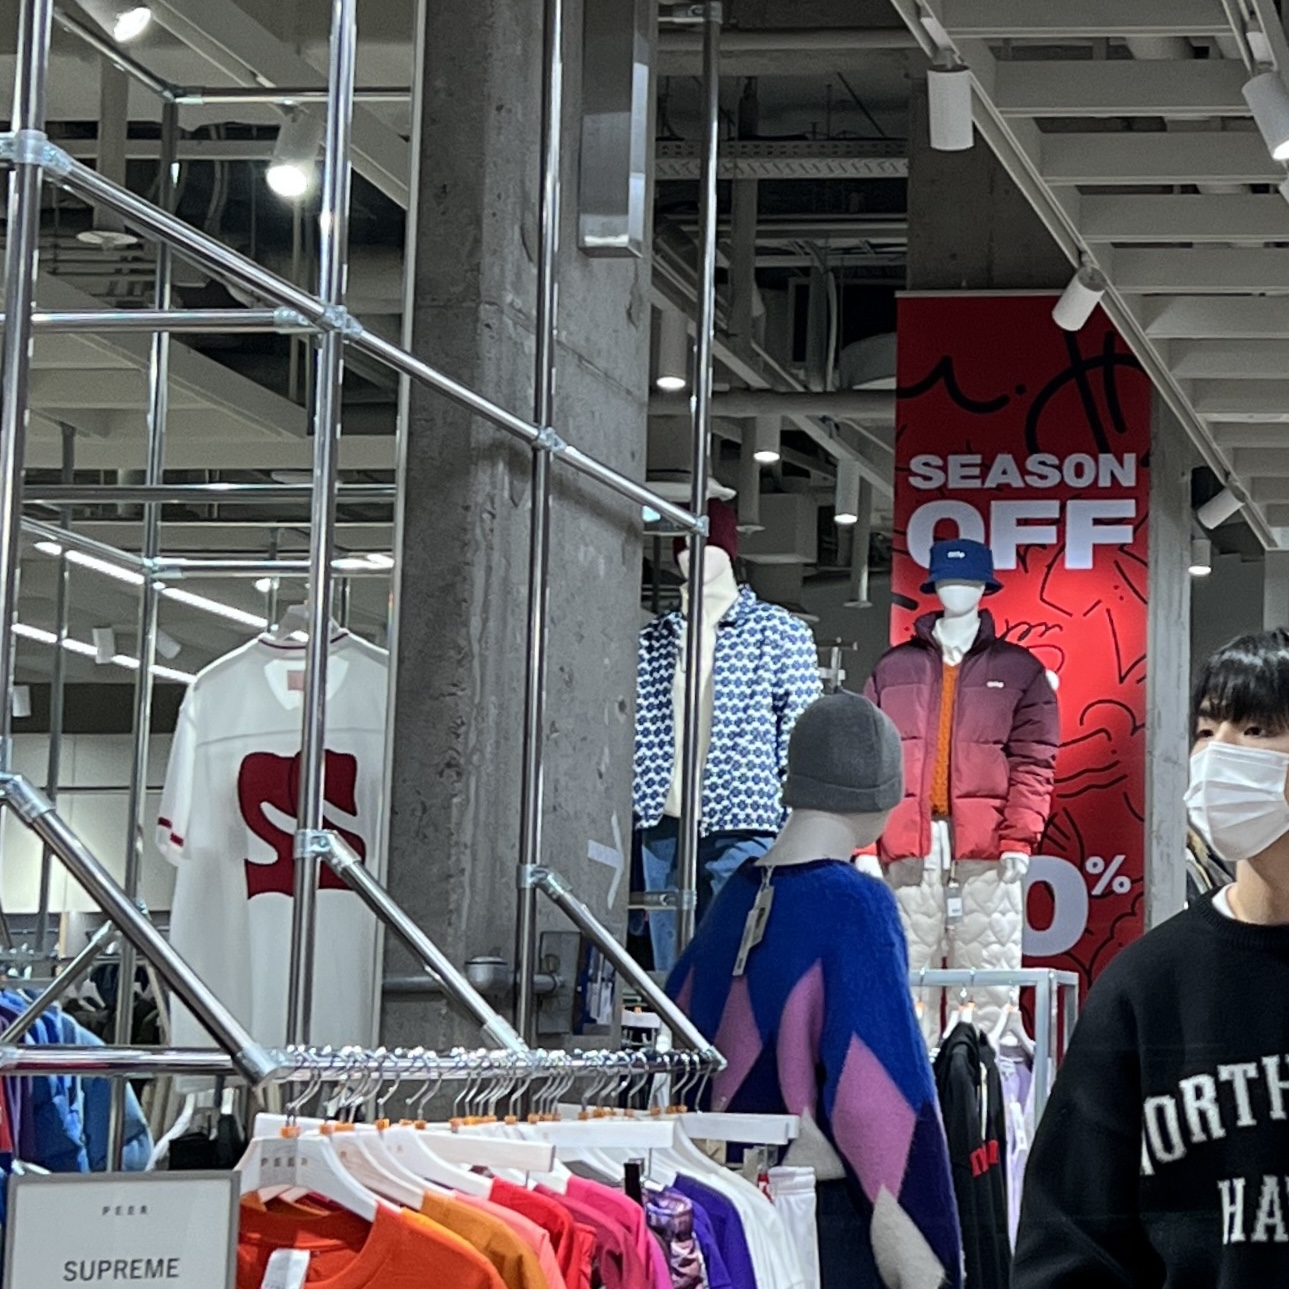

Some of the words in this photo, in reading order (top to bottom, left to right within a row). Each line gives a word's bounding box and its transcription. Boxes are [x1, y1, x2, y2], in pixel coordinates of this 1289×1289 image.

[908, 453, 1136, 489] SEASON
[906, 498, 1136, 570] OFF
[101, 1205, 149, 1216] PEER
[63, 1258, 180, 1282] SUPREME
